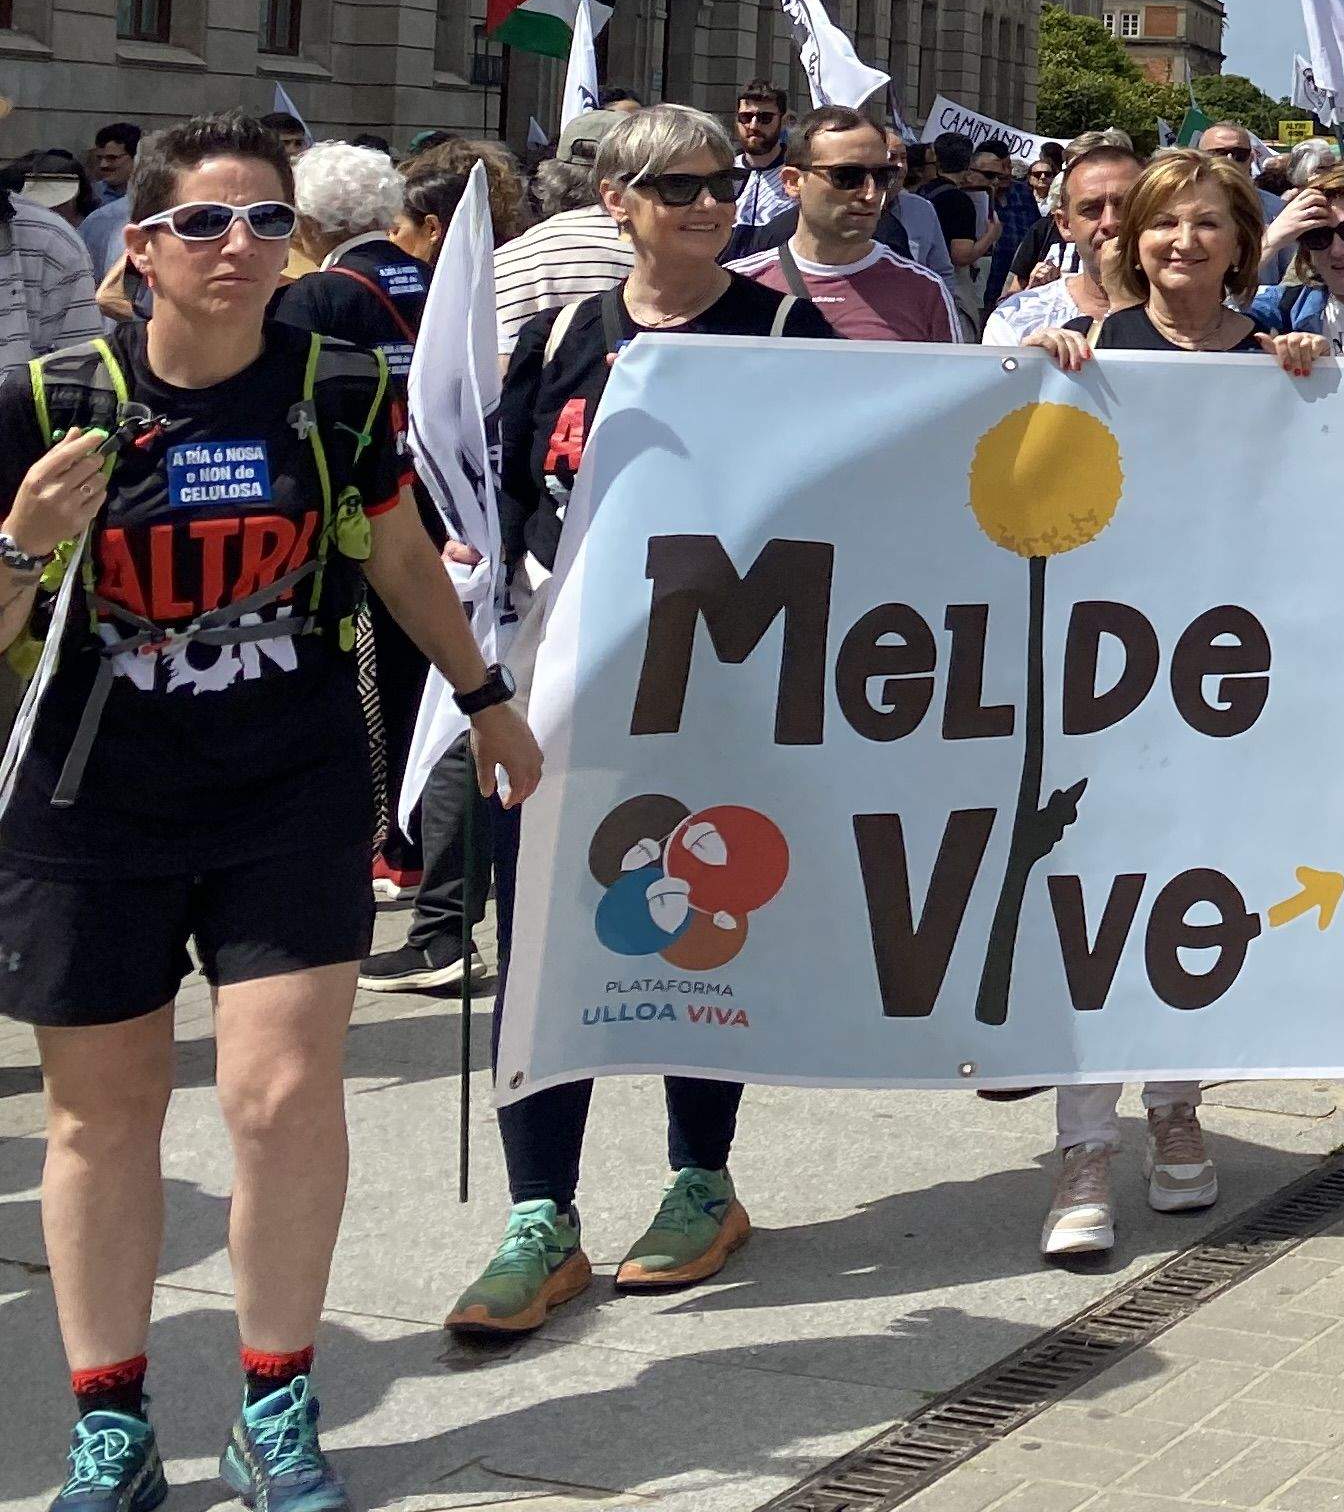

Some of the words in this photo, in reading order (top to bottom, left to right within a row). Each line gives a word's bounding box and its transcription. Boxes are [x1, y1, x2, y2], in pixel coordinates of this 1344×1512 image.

[172, 451, 184, 467] A
[185, 446, 211, 466] RÍA
[225, 446, 264, 464] NOSA
[199, 466, 232, 482] NON
[235, 464, 255, 481] de
[180, 481, 263, 503] CELULOSA
[605, 978, 734, 998] PLATAFORMA
[581, 1002, 677, 1026] ULLOA
[687, 1003, 750, 1028] VIVA
